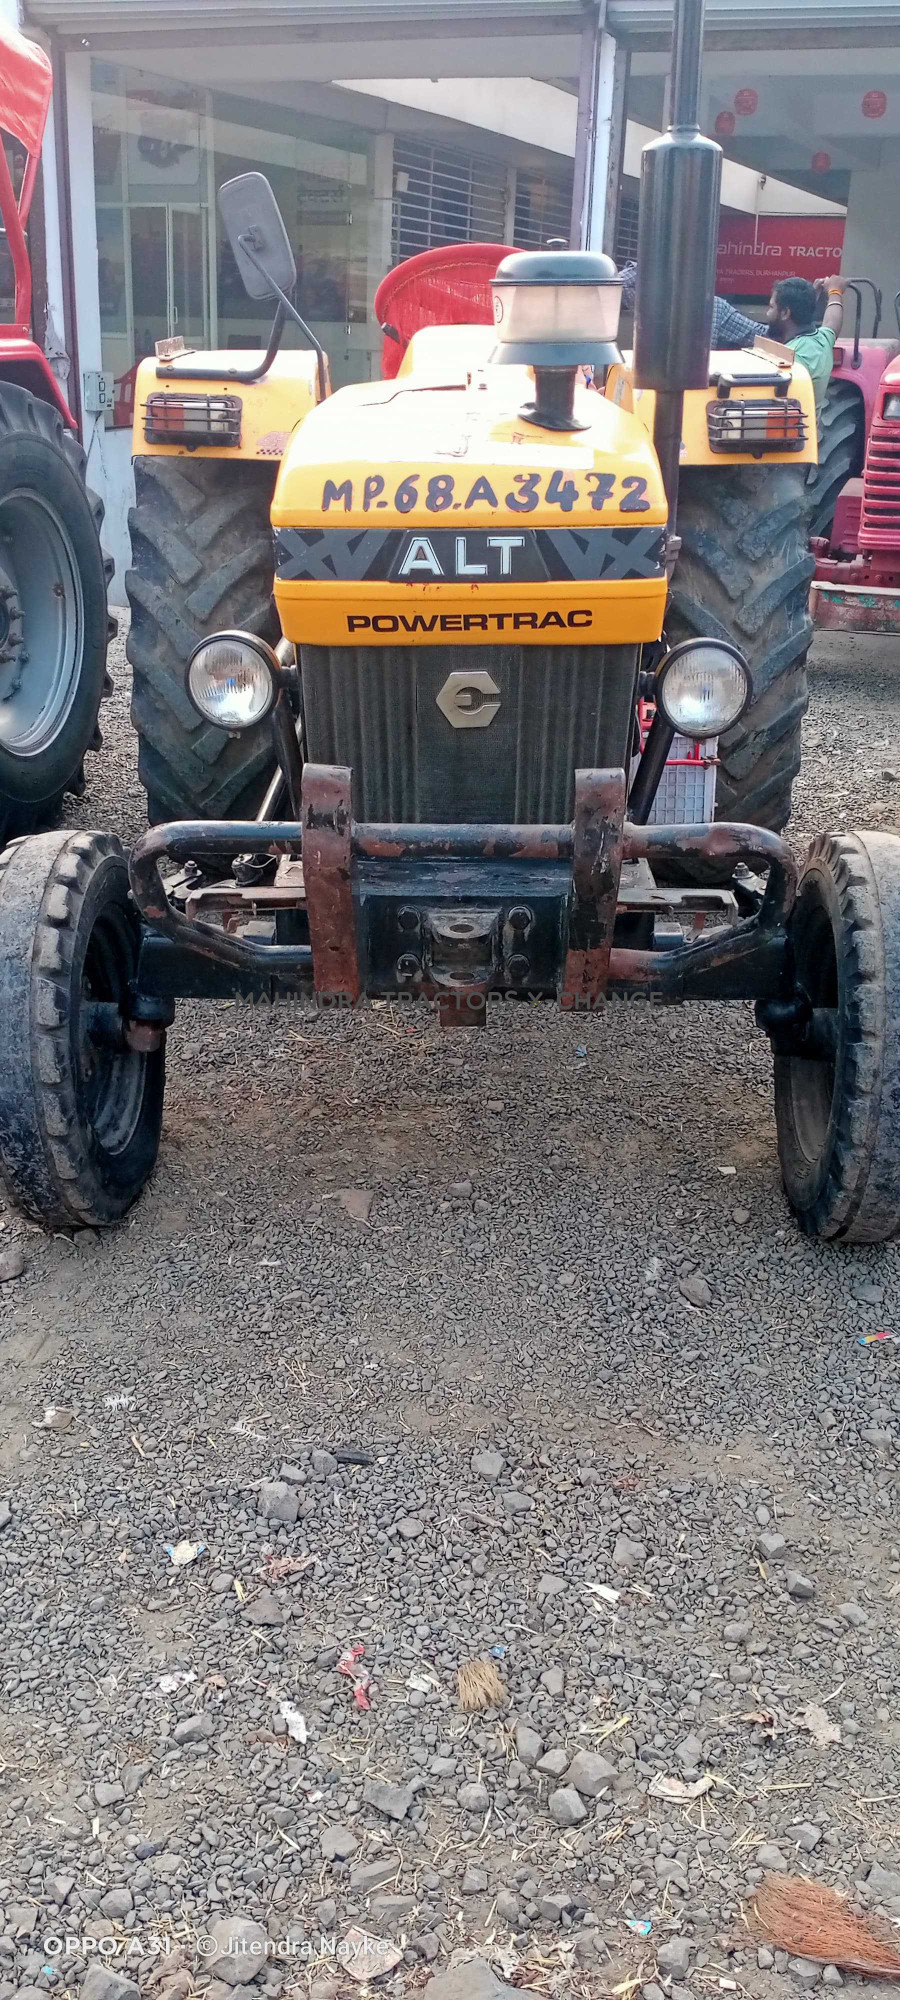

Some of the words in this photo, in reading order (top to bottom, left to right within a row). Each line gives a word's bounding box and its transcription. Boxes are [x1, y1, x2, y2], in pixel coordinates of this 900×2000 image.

[717, 241, 782, 257] ahindra
[788, 246, 843, 258] TRACTO
[398, 536, 526, 576] ALT
[347, 609, 593, 633] POWERTRAC
